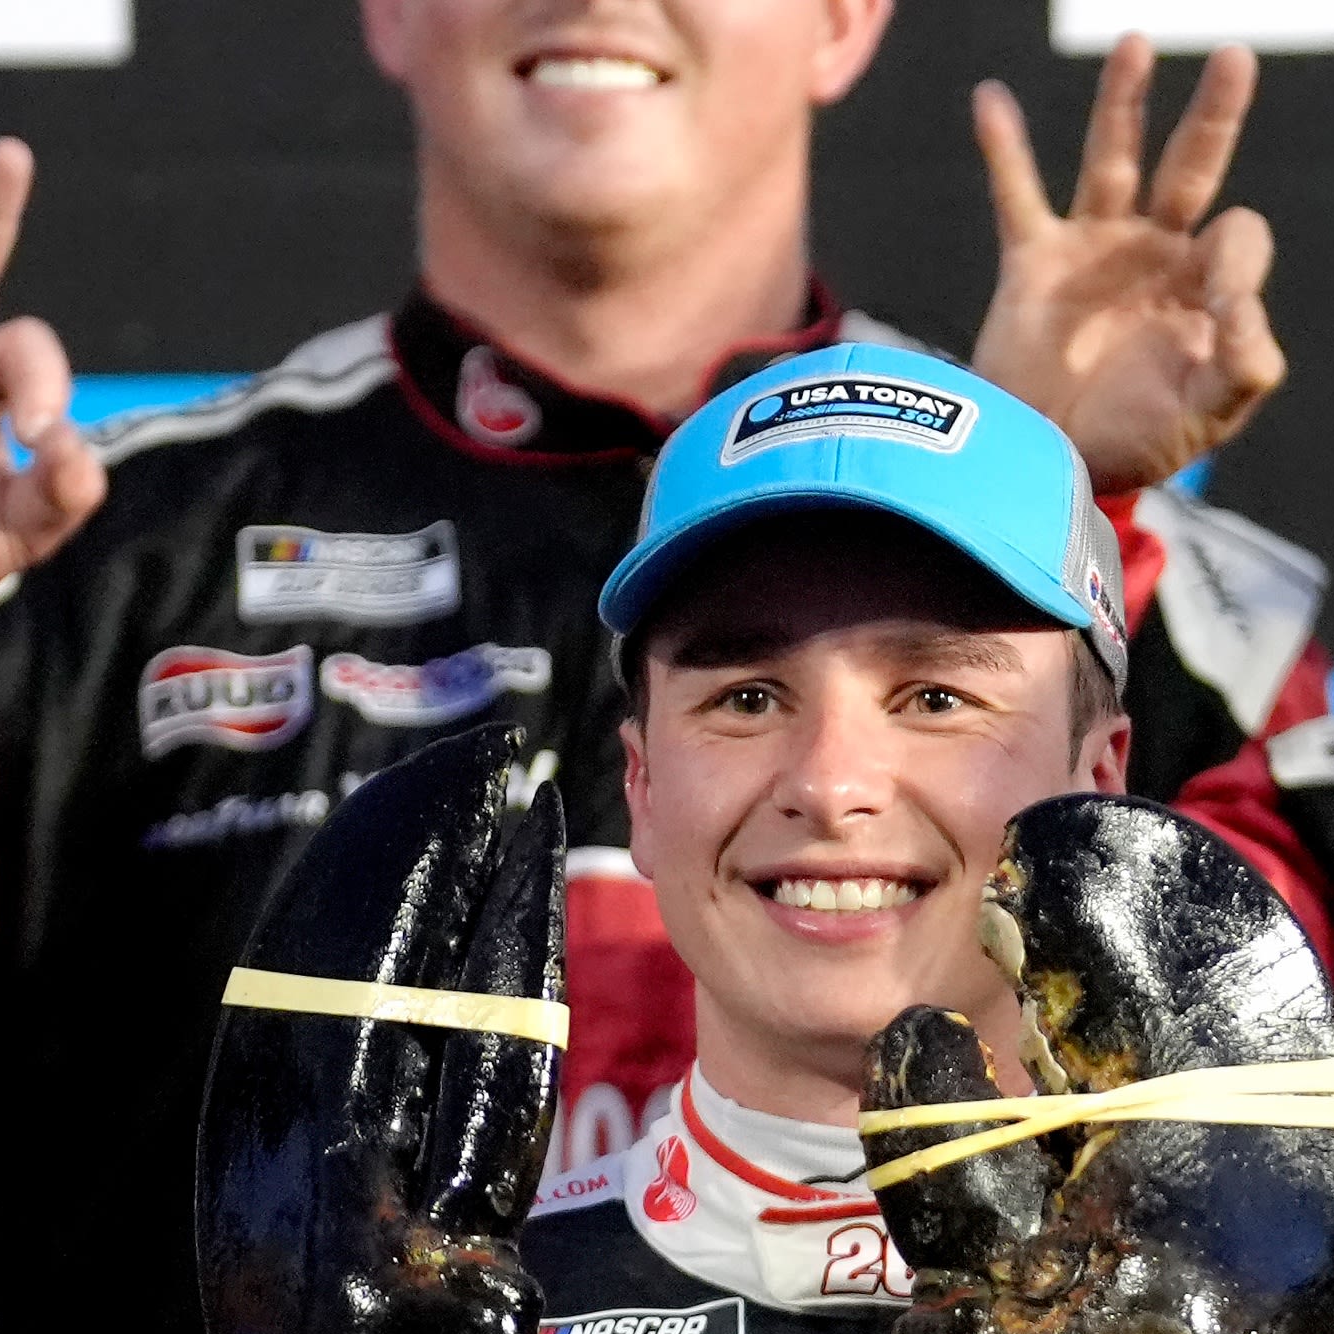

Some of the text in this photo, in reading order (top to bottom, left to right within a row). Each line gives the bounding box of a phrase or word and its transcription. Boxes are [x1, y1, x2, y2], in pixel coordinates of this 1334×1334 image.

[790, 384, 955, 418] USA TODAY
[899, 408, 947, 429] 301
